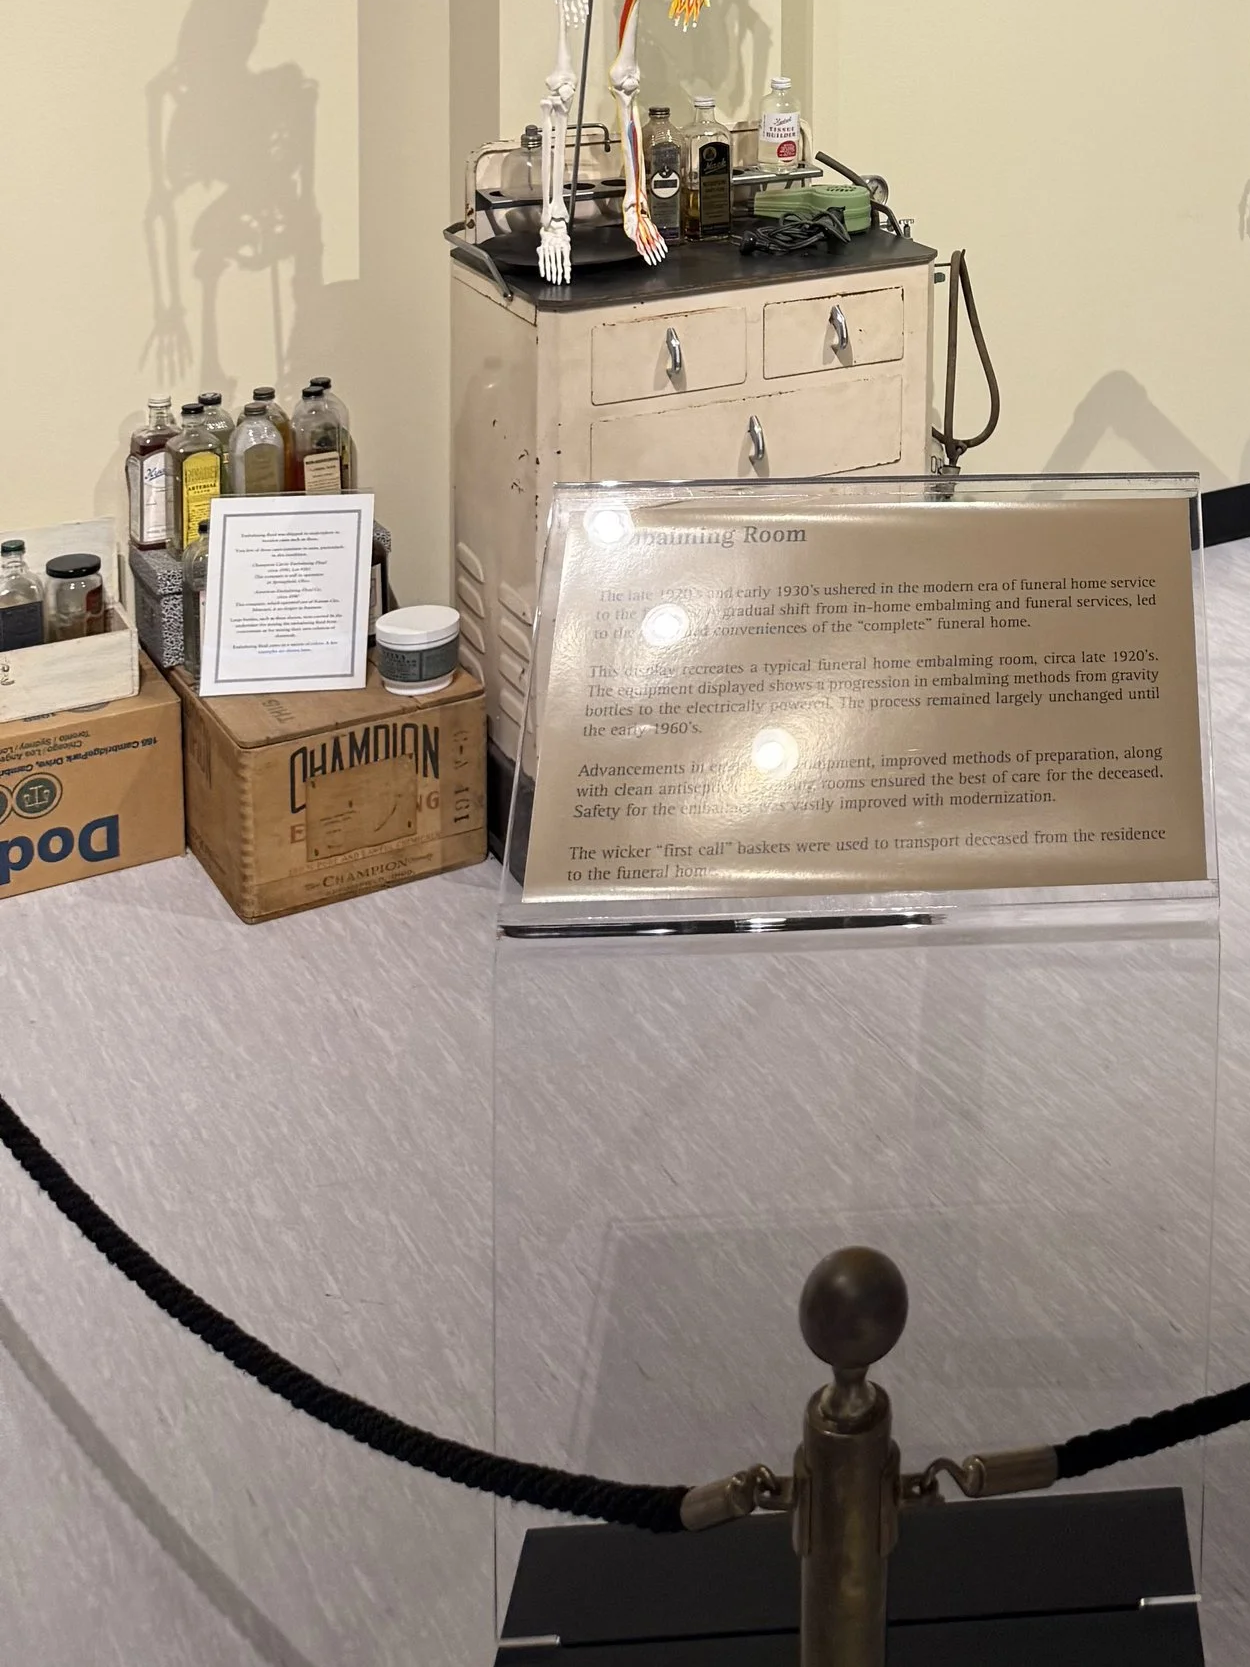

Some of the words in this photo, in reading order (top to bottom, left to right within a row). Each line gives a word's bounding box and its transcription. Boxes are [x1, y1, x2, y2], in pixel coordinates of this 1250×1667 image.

[627, 527, 736, 548] balming
[743, 526, 807, 543] Room
[737, 586, 772, 600] early
[778, 584, 820, 597] 1930's
[824, 582, 876, 596] ushered
[880, 584, 893, 594] in
[898, 582, 919, 594] the
[923, 581, 973, 592] modern
[978, 582, 998, 592] era
[1002, 579, 1017, 591] of
[1020, 578, 1067, 591] funeral
[1071, 578, 1107, 590] home
[1110, 577, 1156, 589] service
[723, 603, 775, 620] gradual
[780, 602, 810, 616] shift
[816, 602, 848, 614] from
[853, 600, 911, 613] in-home
[916, 598, 991, 612] embalming
[996, 597, 1020, 610] and
[1026, 596, 1072, 609] funeral
[1077, 595, 1132, 608] services,
[1138, 594, 1157, 606] led
[714, 622, 807, 638] conveniences
[813, 621, 827, 633] of
[831, 620, 852, 632] the
[937, 617, 985, 630] funeral
[991, 616, 1031, 629] home.
[589, 665, 618, 678] This
[624, 665, 676, 679] display
[682, 664, 744, 676] recreates
[751, 664, 758, 673] a
[764, 660, 811, 675] typical
[818, 658, 866, 671] funeral
[873, 657, 911, 669] home
[916, 654, 993, 669] embalming
[999, 654, 1038, 667] room,
[1044, 652, 1076, 664] circa
[1082, 651, 1106, 663] late
[1113, 649, 1159, 662] 1920's.
[589, 684, 614, 698] The
[618, 683, 693, 698] equipment
[698, 681, 764, 696] displayed
[770, 679, 813, 692] shows
[816, 680, 824, 690] a
[829, 676, 909, 693] progression
[914, 674, 928, 687] in
[932, 672, 1010, 687] embalming
[1014, 671, 1071, 684] methods
[1076, 670, 1107, 683] from
[1111, 668, 1159, 684] gravity
[586, 703, 634, 718] bottles
[639, 704, 653, 715] to
[659, 702, 682, 715] the
[686, 699, 765, 715] electrically
[839, 695, 864, 709] The
[870, 696, 921, 710] process
[927, 692, 990, 706] remained
[996, 691, 1042, 705] largely
[1049, 688, 1123, 704] unchanged
[1128, 687, 1160, 700] until
[584, 723, 606, 737] the
[610, 723, 652, 738] early
[654, 721, 702, 735] 1960's.
[290, 723, 439, 814] CHAMPION
[578, 763, 685, 777] Advancements
[691, 763, 704, 774] in
[881, 752, 947, 770] improved
[952, 752, 1012, 766] methods
[1016, 750, 1032, 762] of
[1036, 748, 1118, 764] preparation,
[1124, 746, 1163, 761] along
[577, 785, 608, 798] with
[614, 783, 653, 796] clean
[821, 778, 865, 790] rooms
[870, 774, 926, 788] ensured
[931, 772, 954, 786] the
[959, 772, 986, 784] best
[992, 770, 1008, 784] of
[1012, 772, 1041, 783] care
[1047, 768, 1068, 782] for
[1072, 768, 1093, 781] the
[1098, 766, 1164, 780] deceased.
[574, 804, 620, 820] Safety
[625, 802, 648, 817] for
[652, 802, 676, 816] the
[791, 797, 834, 812] vastly
[839, 795, 907, 811] improved
[912, 794, 944, 806] with
[950, 790, 1056, 806] modernization.
[570, 846, 597, 860] The
[602, 845, 651, 860] wicker
[737, 840, 791, 855] baskets
[796, 840, 831, 853] were
[836, 837, 868, 852] used
[875, 839, 889, 850] to
[894, 835, 961, 852] transport
[965, 832, 1028, 846] deceased
[1034, 830, 1068, 845] from
[1074, 829, 1095, 843] the
[1100, 828, 1166, 842] residence
[322, 858, 408, 887] CHAMPION
[567, 868, 583, 882] to
[588, 867, 611, 881] the
[616, 866, 670, 880] funeral
